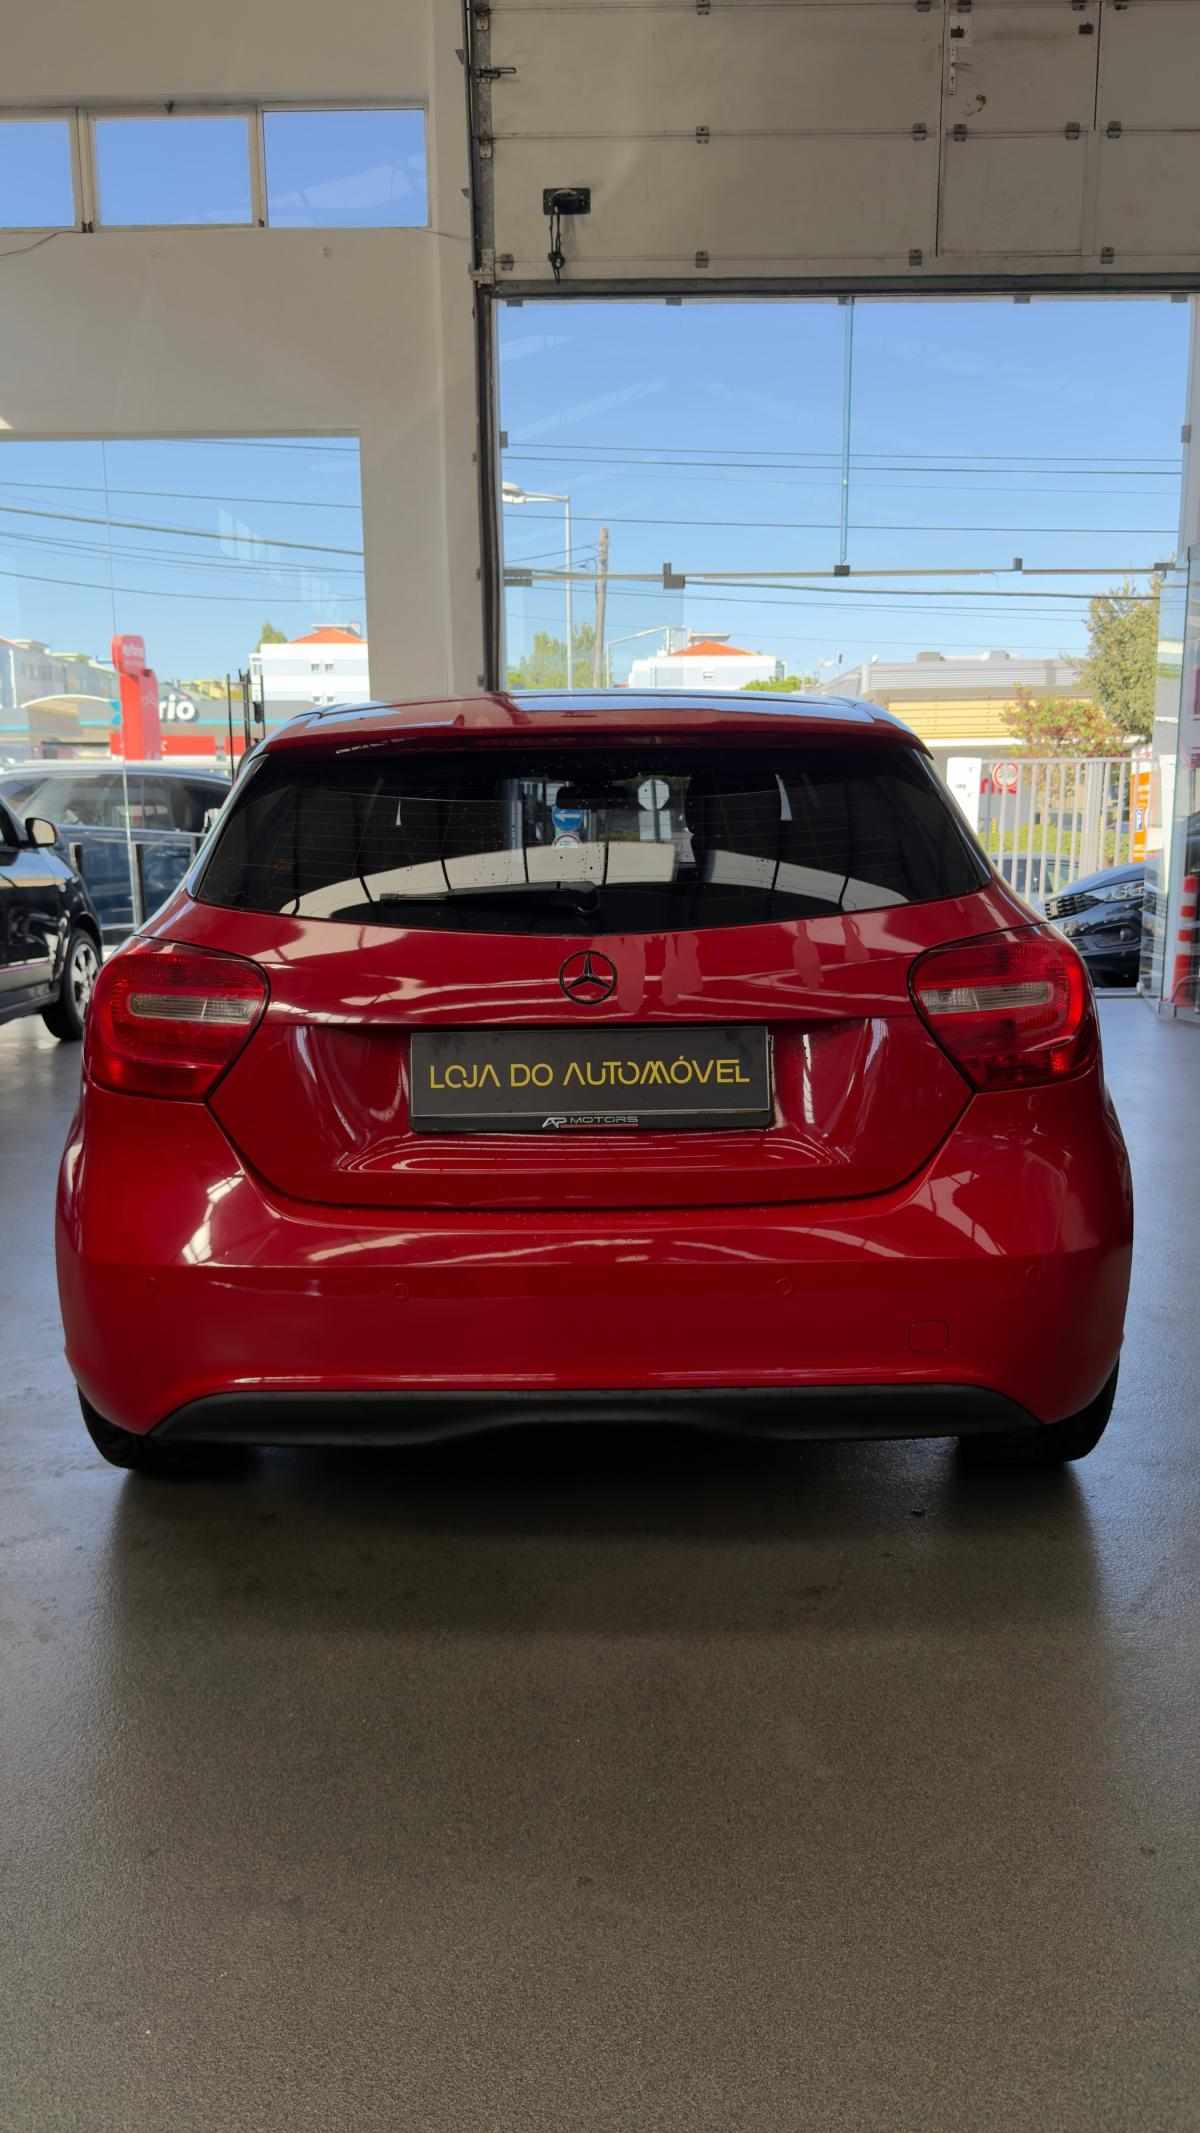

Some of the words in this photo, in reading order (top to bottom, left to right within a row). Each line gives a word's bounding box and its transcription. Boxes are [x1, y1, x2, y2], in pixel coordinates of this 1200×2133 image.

[429, 1063, 501, 1089] LOJA
[510, 1062, 554, 1088] DO
[563, 1055, 751, 1087] AUTOMÓVEL
[569, 1115, 639, 1124] MOTORS
